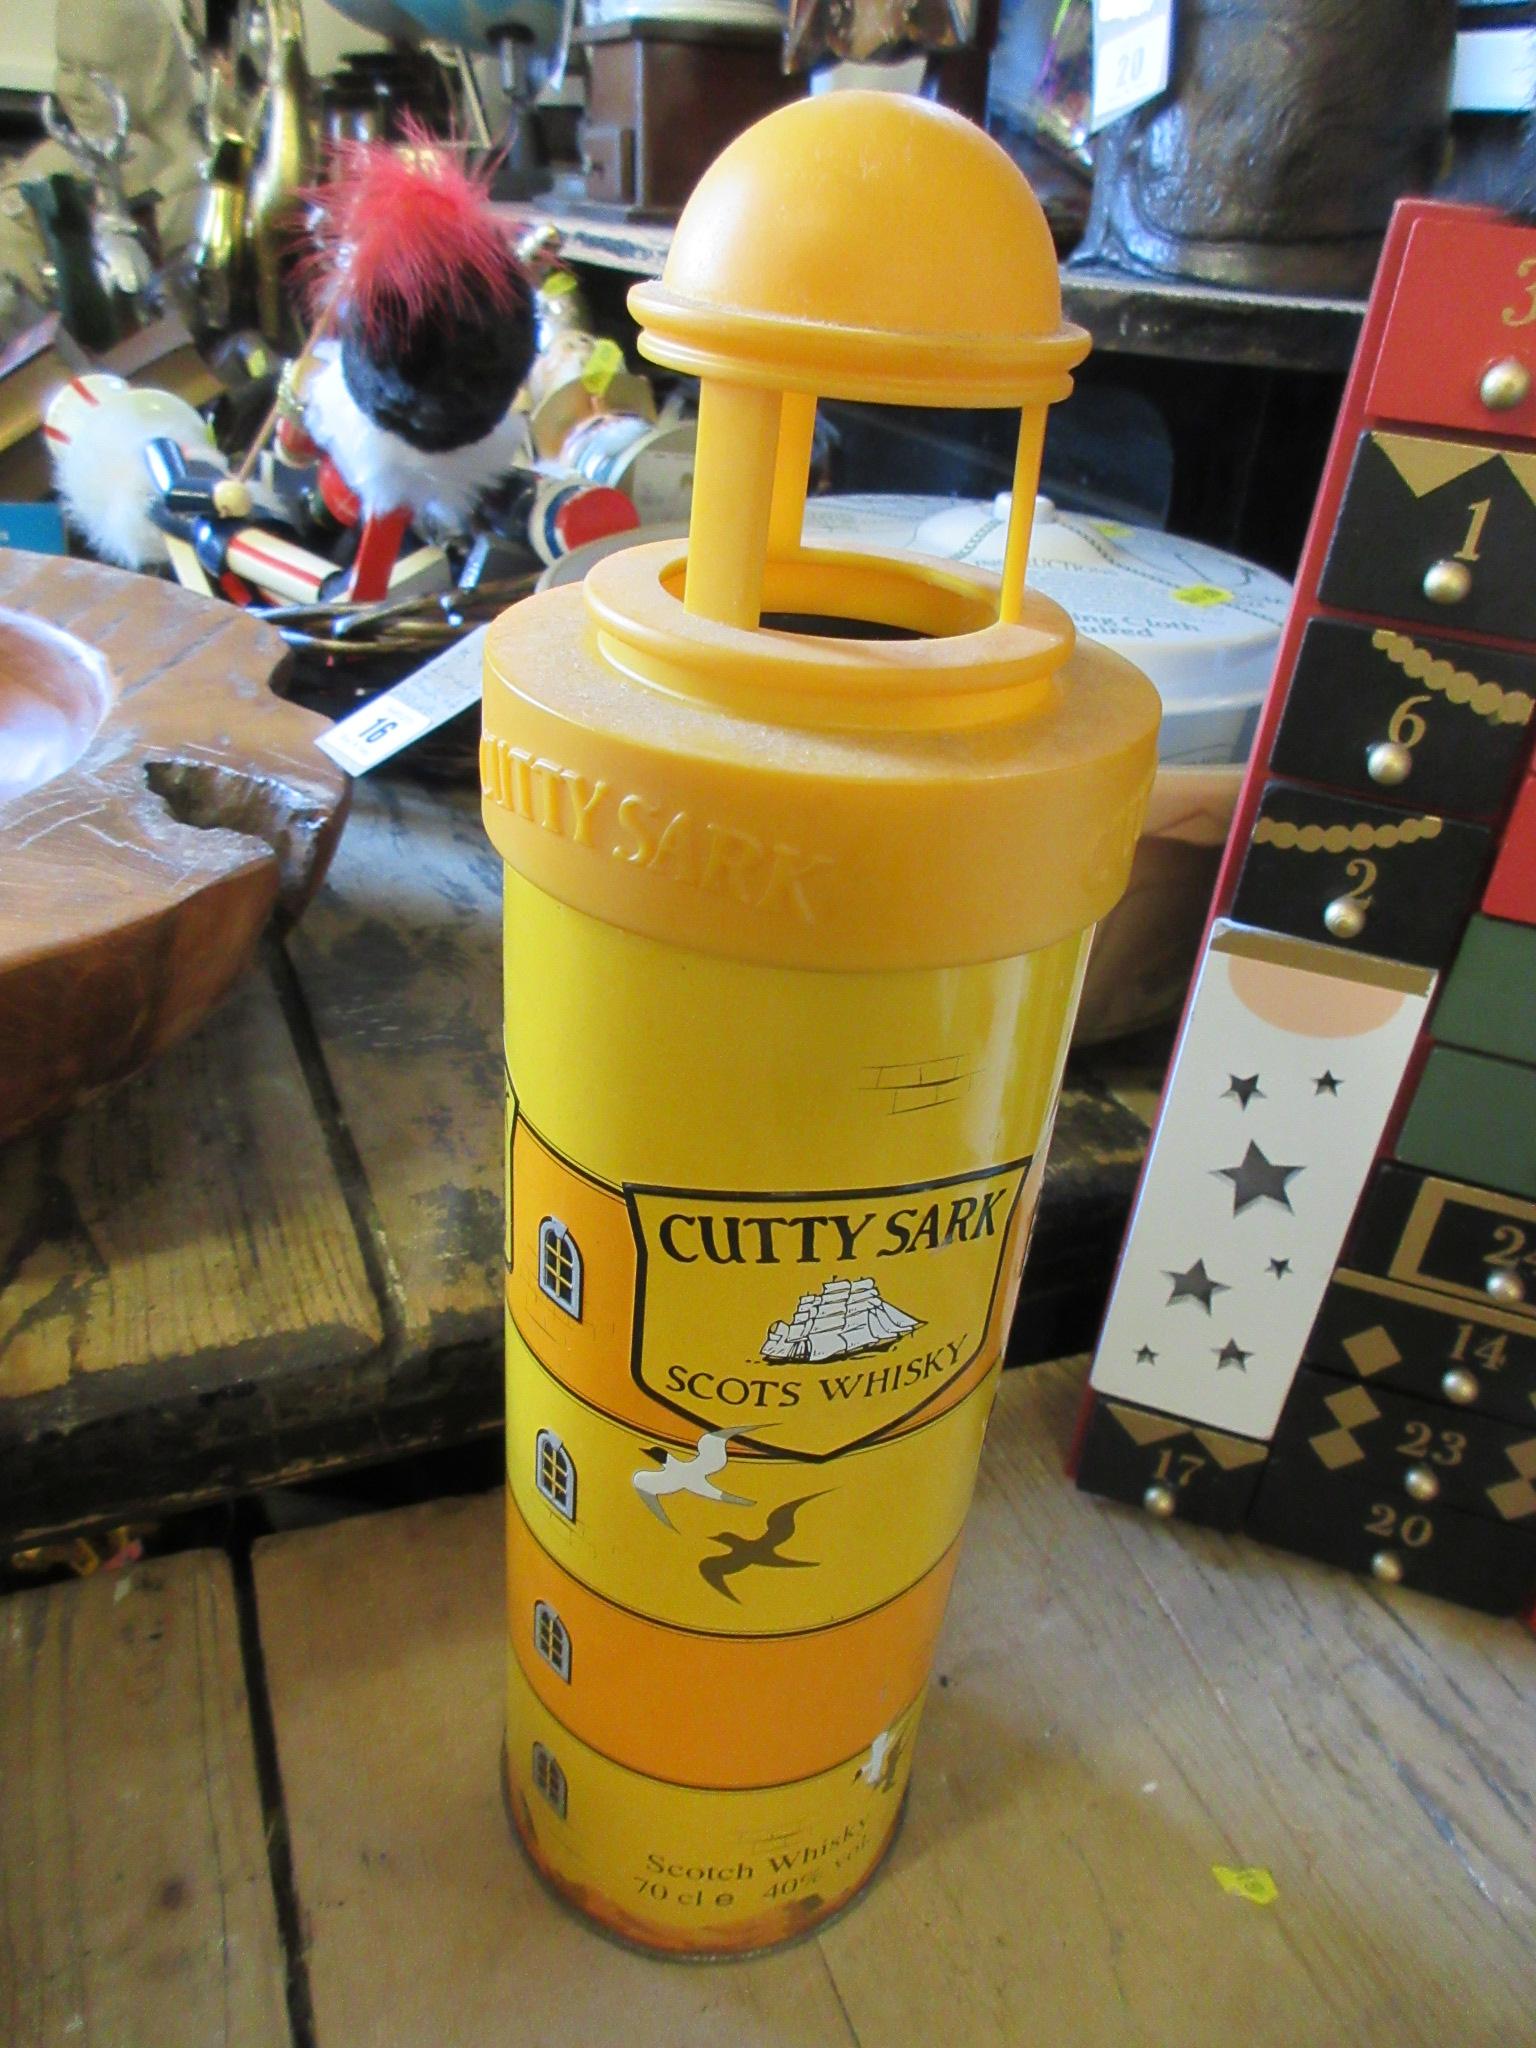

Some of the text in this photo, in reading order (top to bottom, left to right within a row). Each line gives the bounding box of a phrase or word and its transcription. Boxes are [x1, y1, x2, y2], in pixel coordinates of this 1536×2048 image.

[1115, 46, 1145, 89] 20
[1453, 498, 1491, 562] 1
[357, 716, 399, 744] 16
[1387, 695, 1433, 749] 6
[1345, 857, 1377, 909] 2
[658, 1188, 1007, 1265] CUTTY SARK
[1482, 1224, 1536, 1272] 2
[1448, 1324, 1511, 1370] 14
[666, 1333, 968, 1408] SCOTS WHISKY
[1396, 1421, 1468, 1467] 23
[1154, 1448, 1206, 1488] 17
[1365, 1503, 1435, 1549] 20
[633, 1876, 668, 1901] 70
[646, 1853, 754, 1883] Scotch
